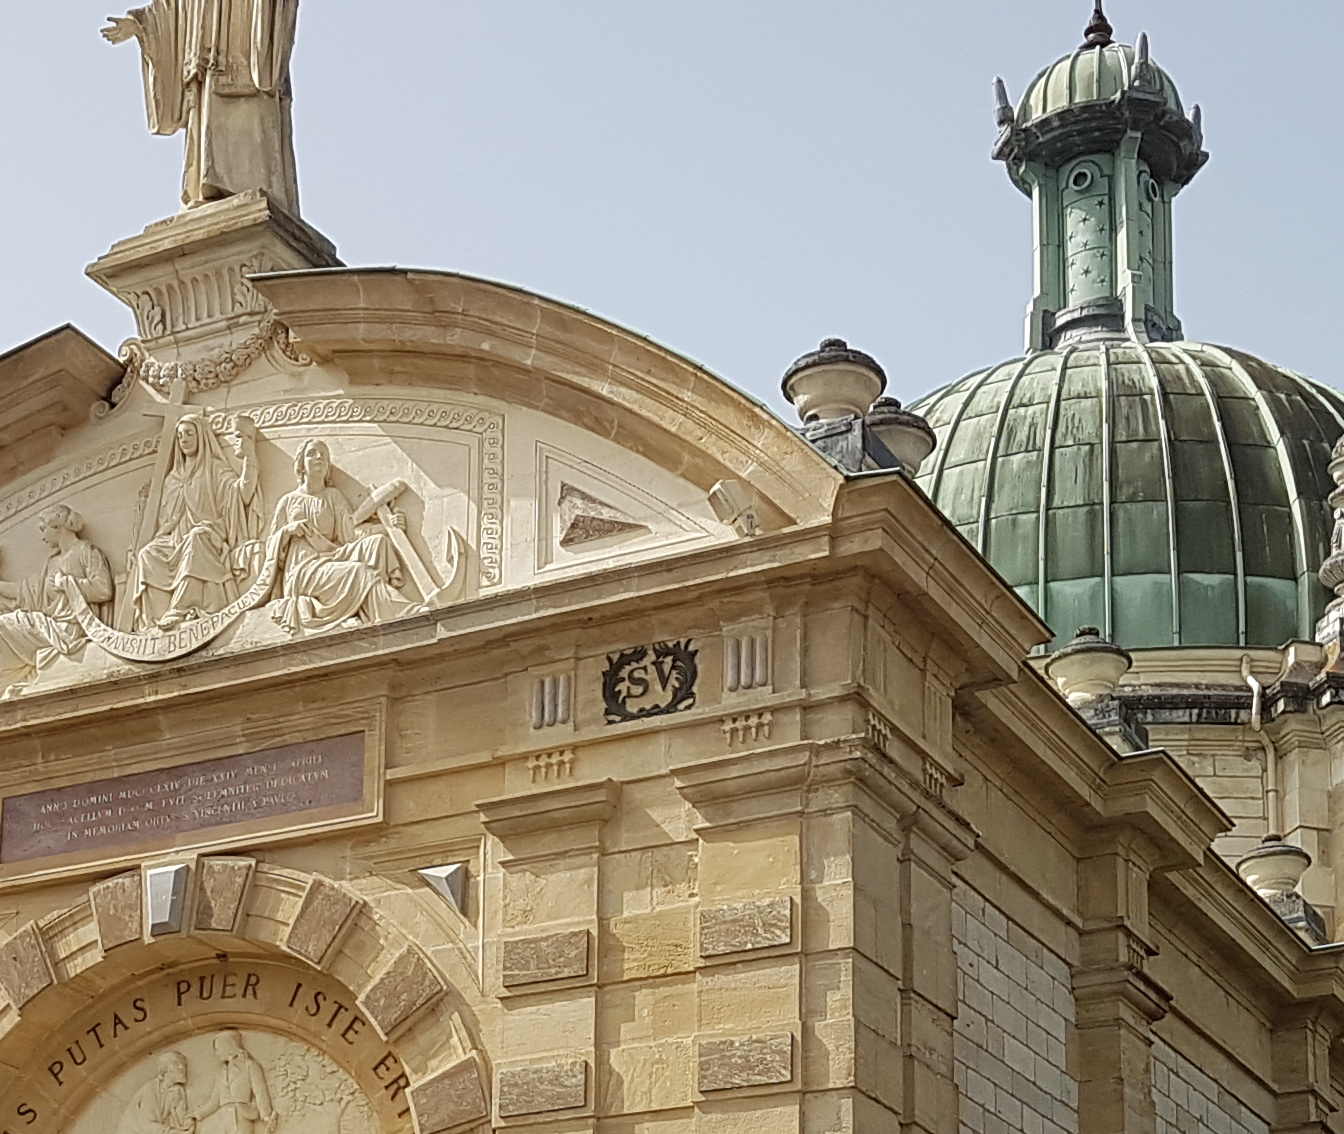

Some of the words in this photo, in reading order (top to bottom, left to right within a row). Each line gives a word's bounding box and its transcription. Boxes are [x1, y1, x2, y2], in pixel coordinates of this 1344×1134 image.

[626, 657, 675, 698] SV
[72, 792, 114, 808] DOMINI
[47, 997, 149, 1086] PUTAS
[175, 973, 261, 1007] PUER
[289, 982, 366, 1045] ISTE
